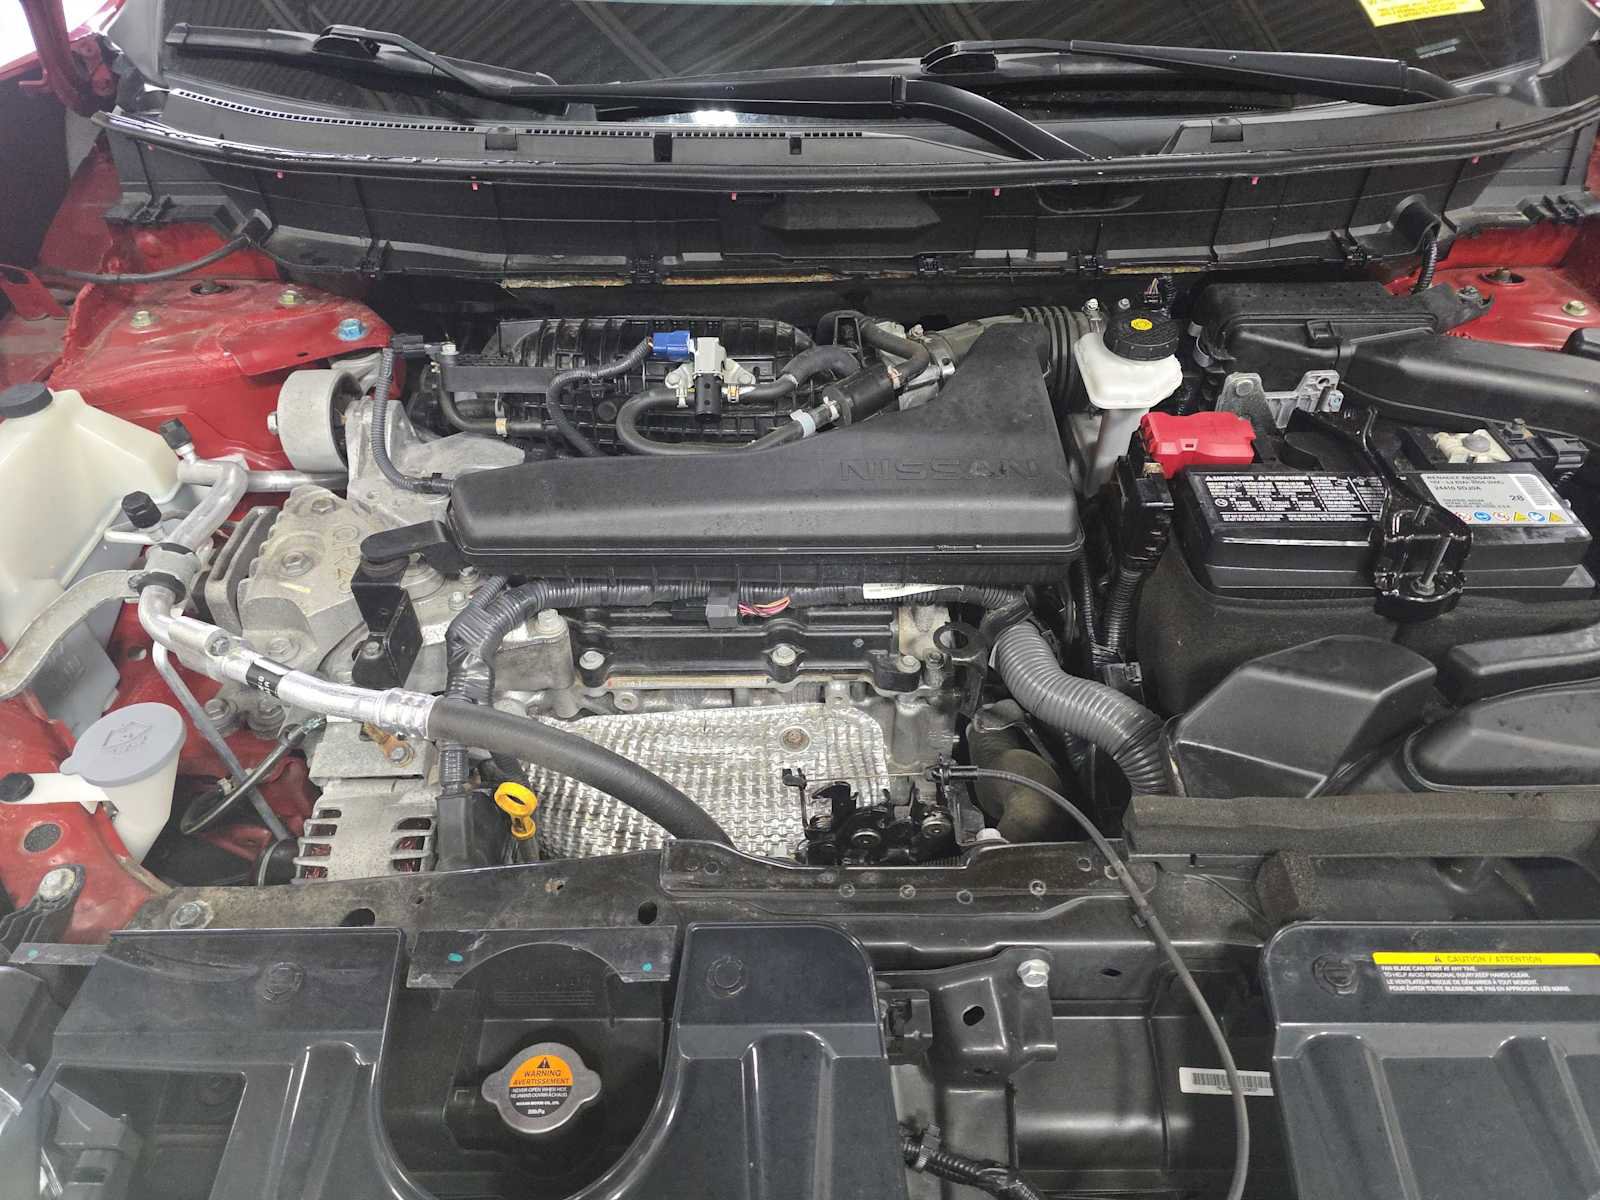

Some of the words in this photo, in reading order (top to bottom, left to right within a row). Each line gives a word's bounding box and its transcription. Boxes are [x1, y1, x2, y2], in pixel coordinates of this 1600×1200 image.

[839, 456, 1041, 482] NISSAN
[1447, 955, 1486, 963] CAUTION
[1495, 955, 1543, 963] ATTENTION
[524, 1069, 561, 1077] WARNING
